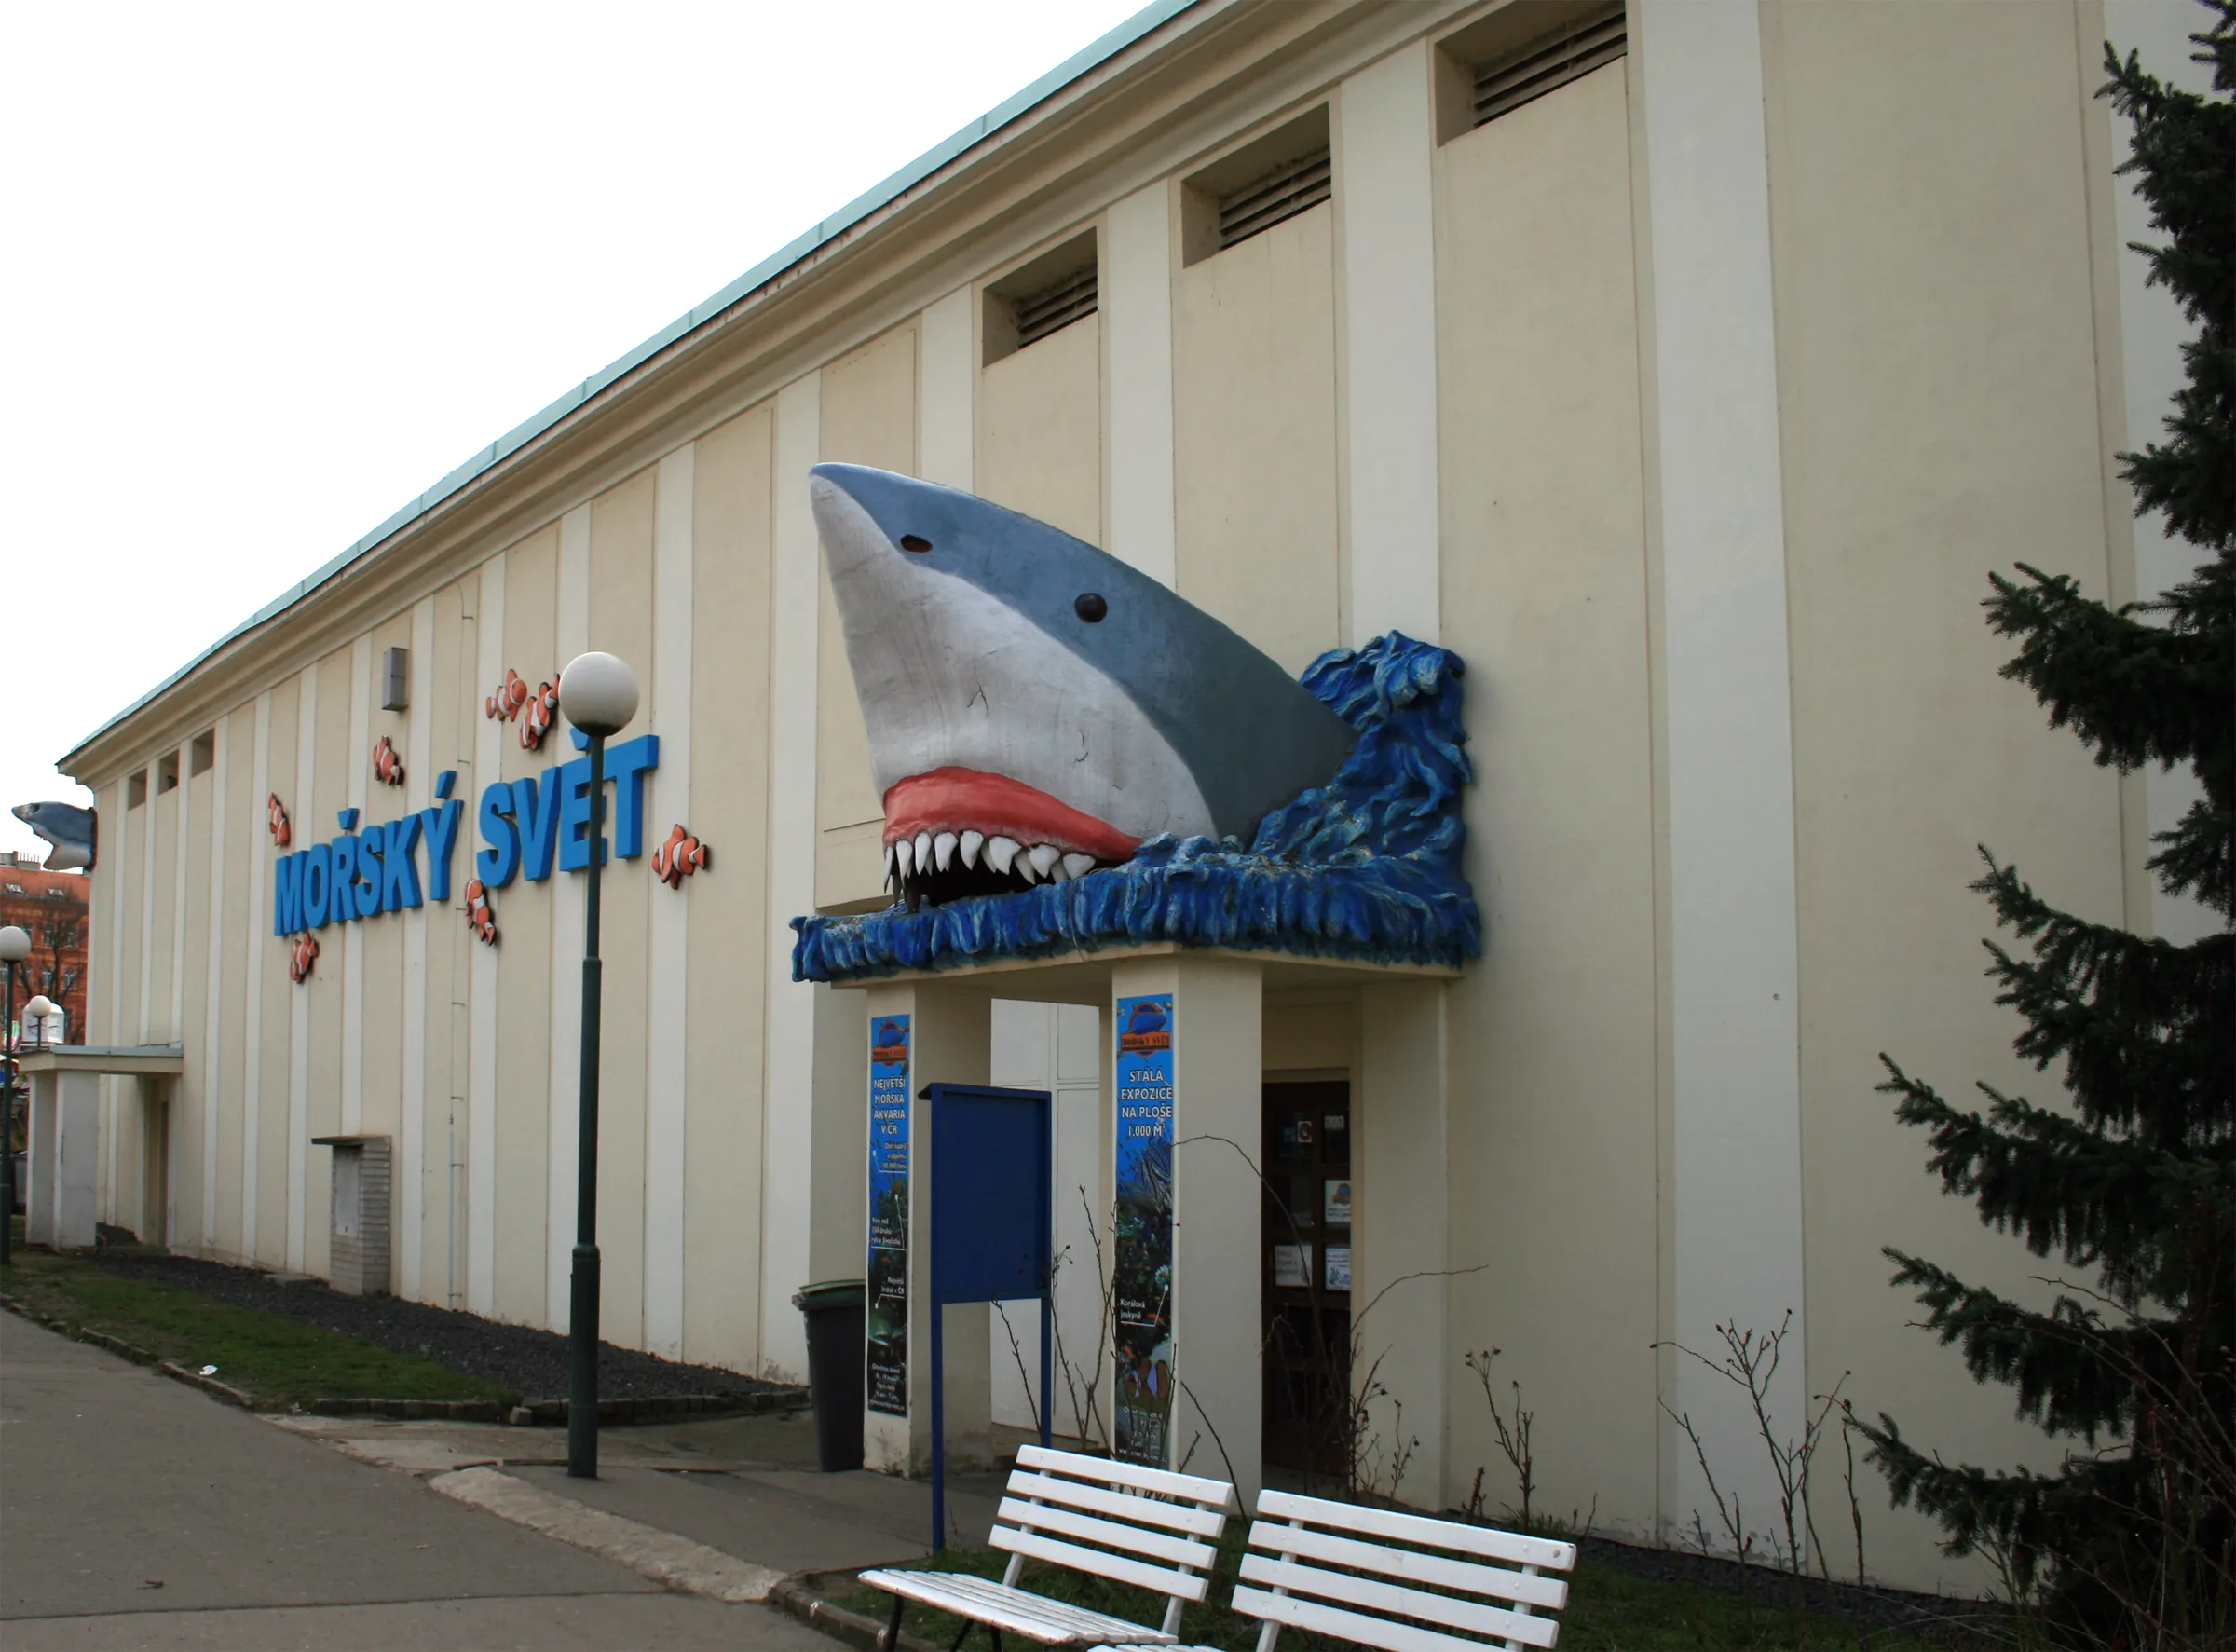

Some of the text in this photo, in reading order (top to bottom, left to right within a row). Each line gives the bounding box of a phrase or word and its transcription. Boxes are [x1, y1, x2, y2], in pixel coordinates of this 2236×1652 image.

[275, 728, 660, 936] MOŘSKÝ SVĚT
[1129, 1066, 1164, 1083] STÁLÁ
[874, 1075, 906, 1090] NEJVĚTŠÍ
[1121, 1087, 1173, 1100] EXPOZICE
[1122, 1102, 1172, 1118] NA PLOŠE
[880, 1122, 898, 1135] V ČR
[1128, 1125, 1151, 1137] 1.000
